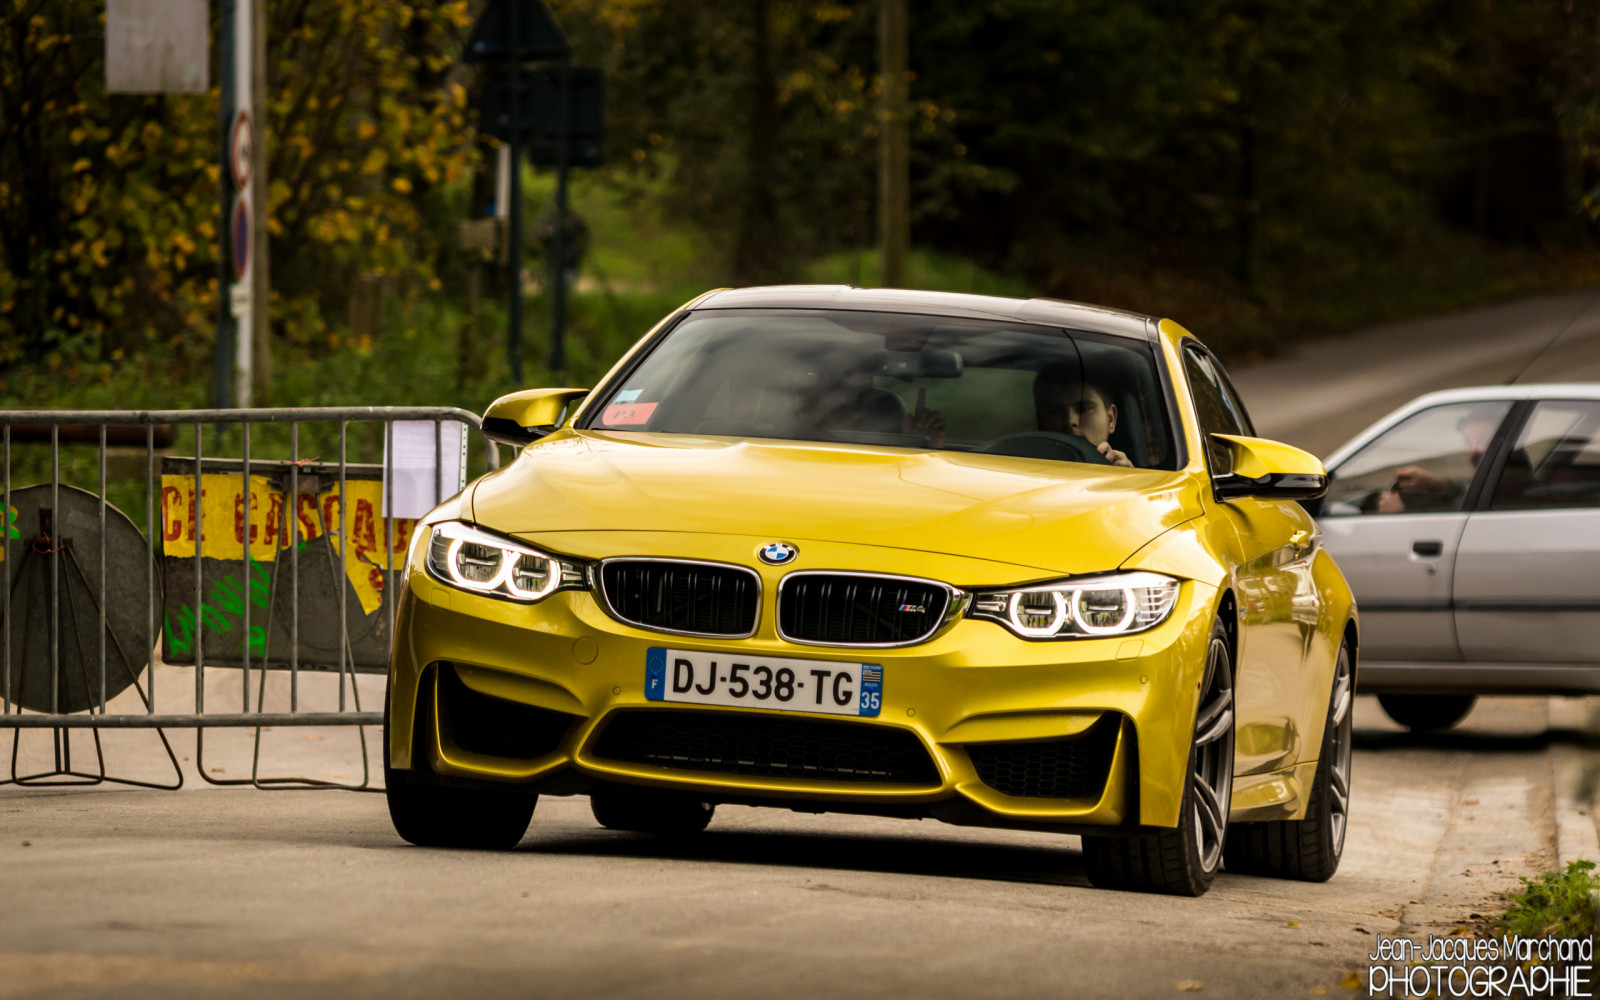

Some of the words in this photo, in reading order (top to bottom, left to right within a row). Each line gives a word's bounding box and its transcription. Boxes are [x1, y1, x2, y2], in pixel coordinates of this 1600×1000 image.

[651, 679, 659, 690] F
[672, 658, 853, 706] DJ-538-TG
[861, 691, 880, 710] 35
